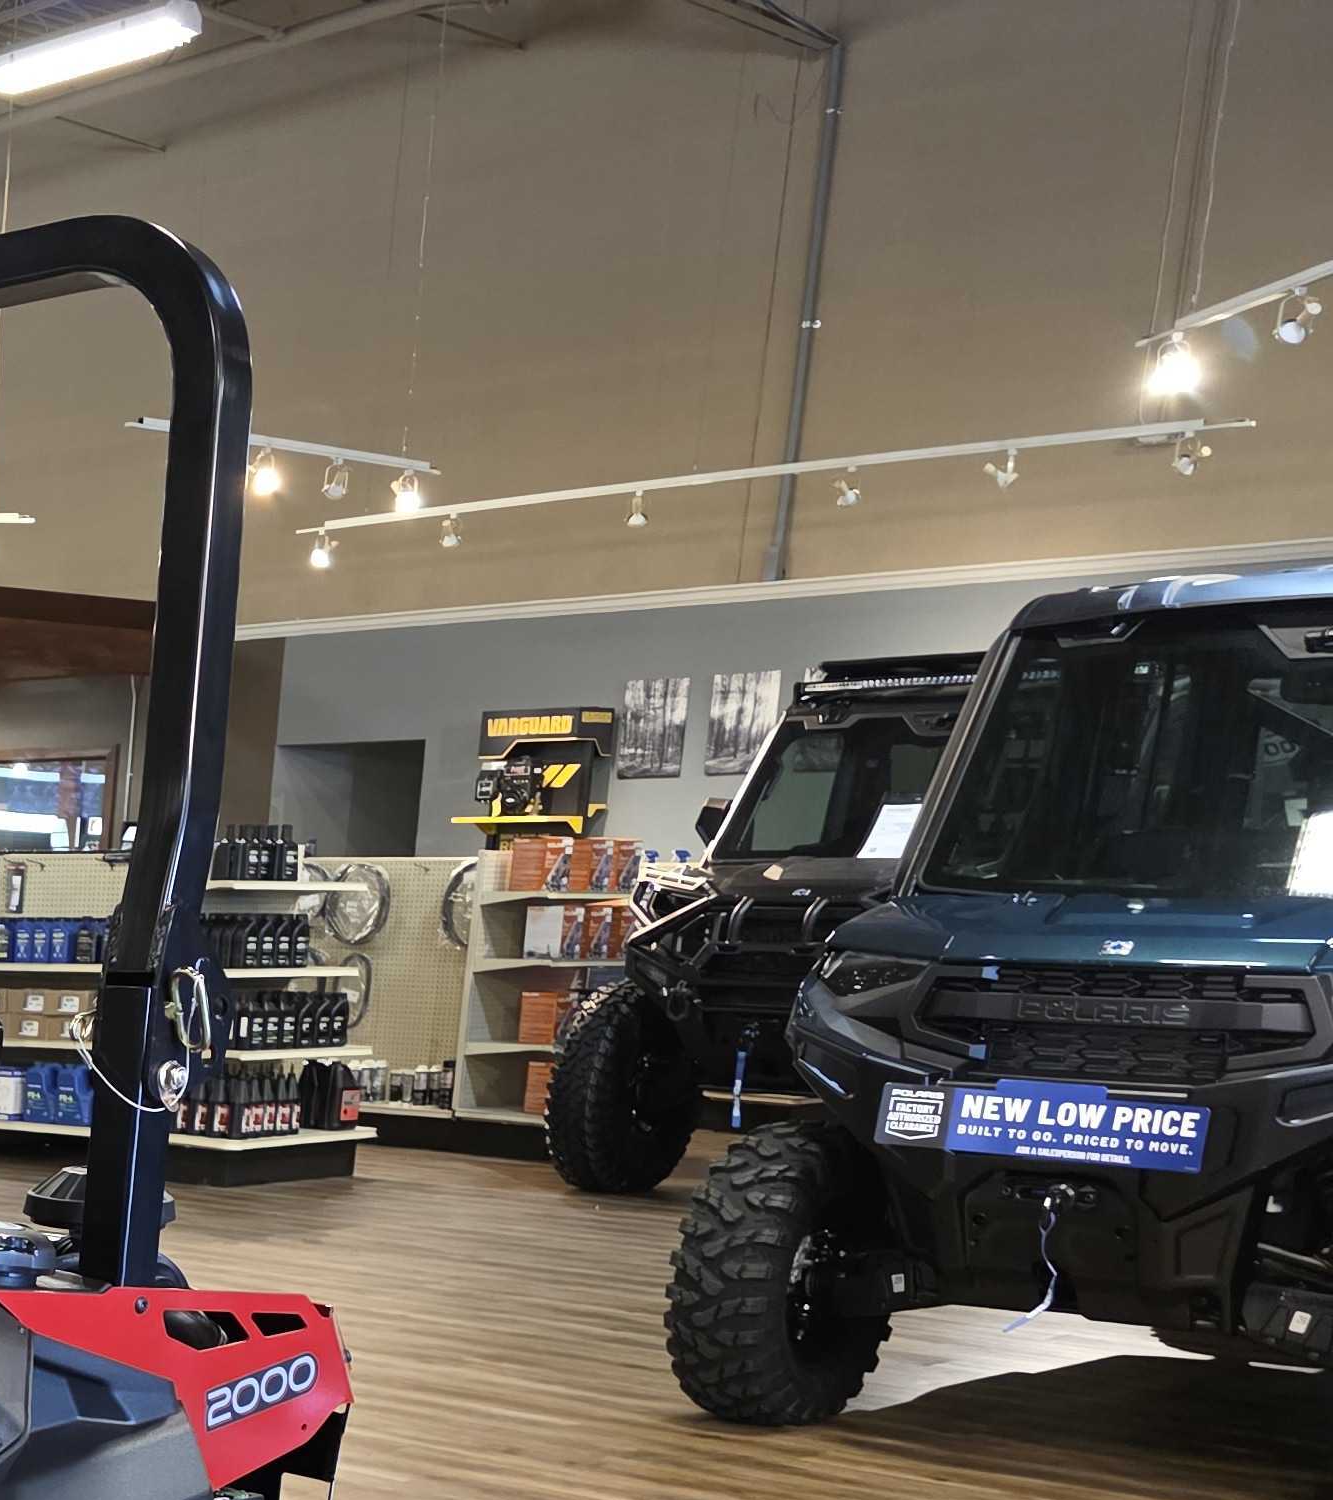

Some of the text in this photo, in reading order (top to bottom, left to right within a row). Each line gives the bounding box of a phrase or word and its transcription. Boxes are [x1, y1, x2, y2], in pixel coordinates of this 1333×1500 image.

[487, 715, 575, 737] VANGUARD
[1017, 1000, 1190, 1026] POLARIS
[891, 1088, 945, 1100] POLARIS
[895, 1102, 936, 1114] FACTORY
[960, 1093, 1201, 1138] NEW LOW PRICE
[956, 1124, 1194, 1156] BUILT TO GO. PRICED TO MOVE.
[207, 1354, 316, 1428] 2000
